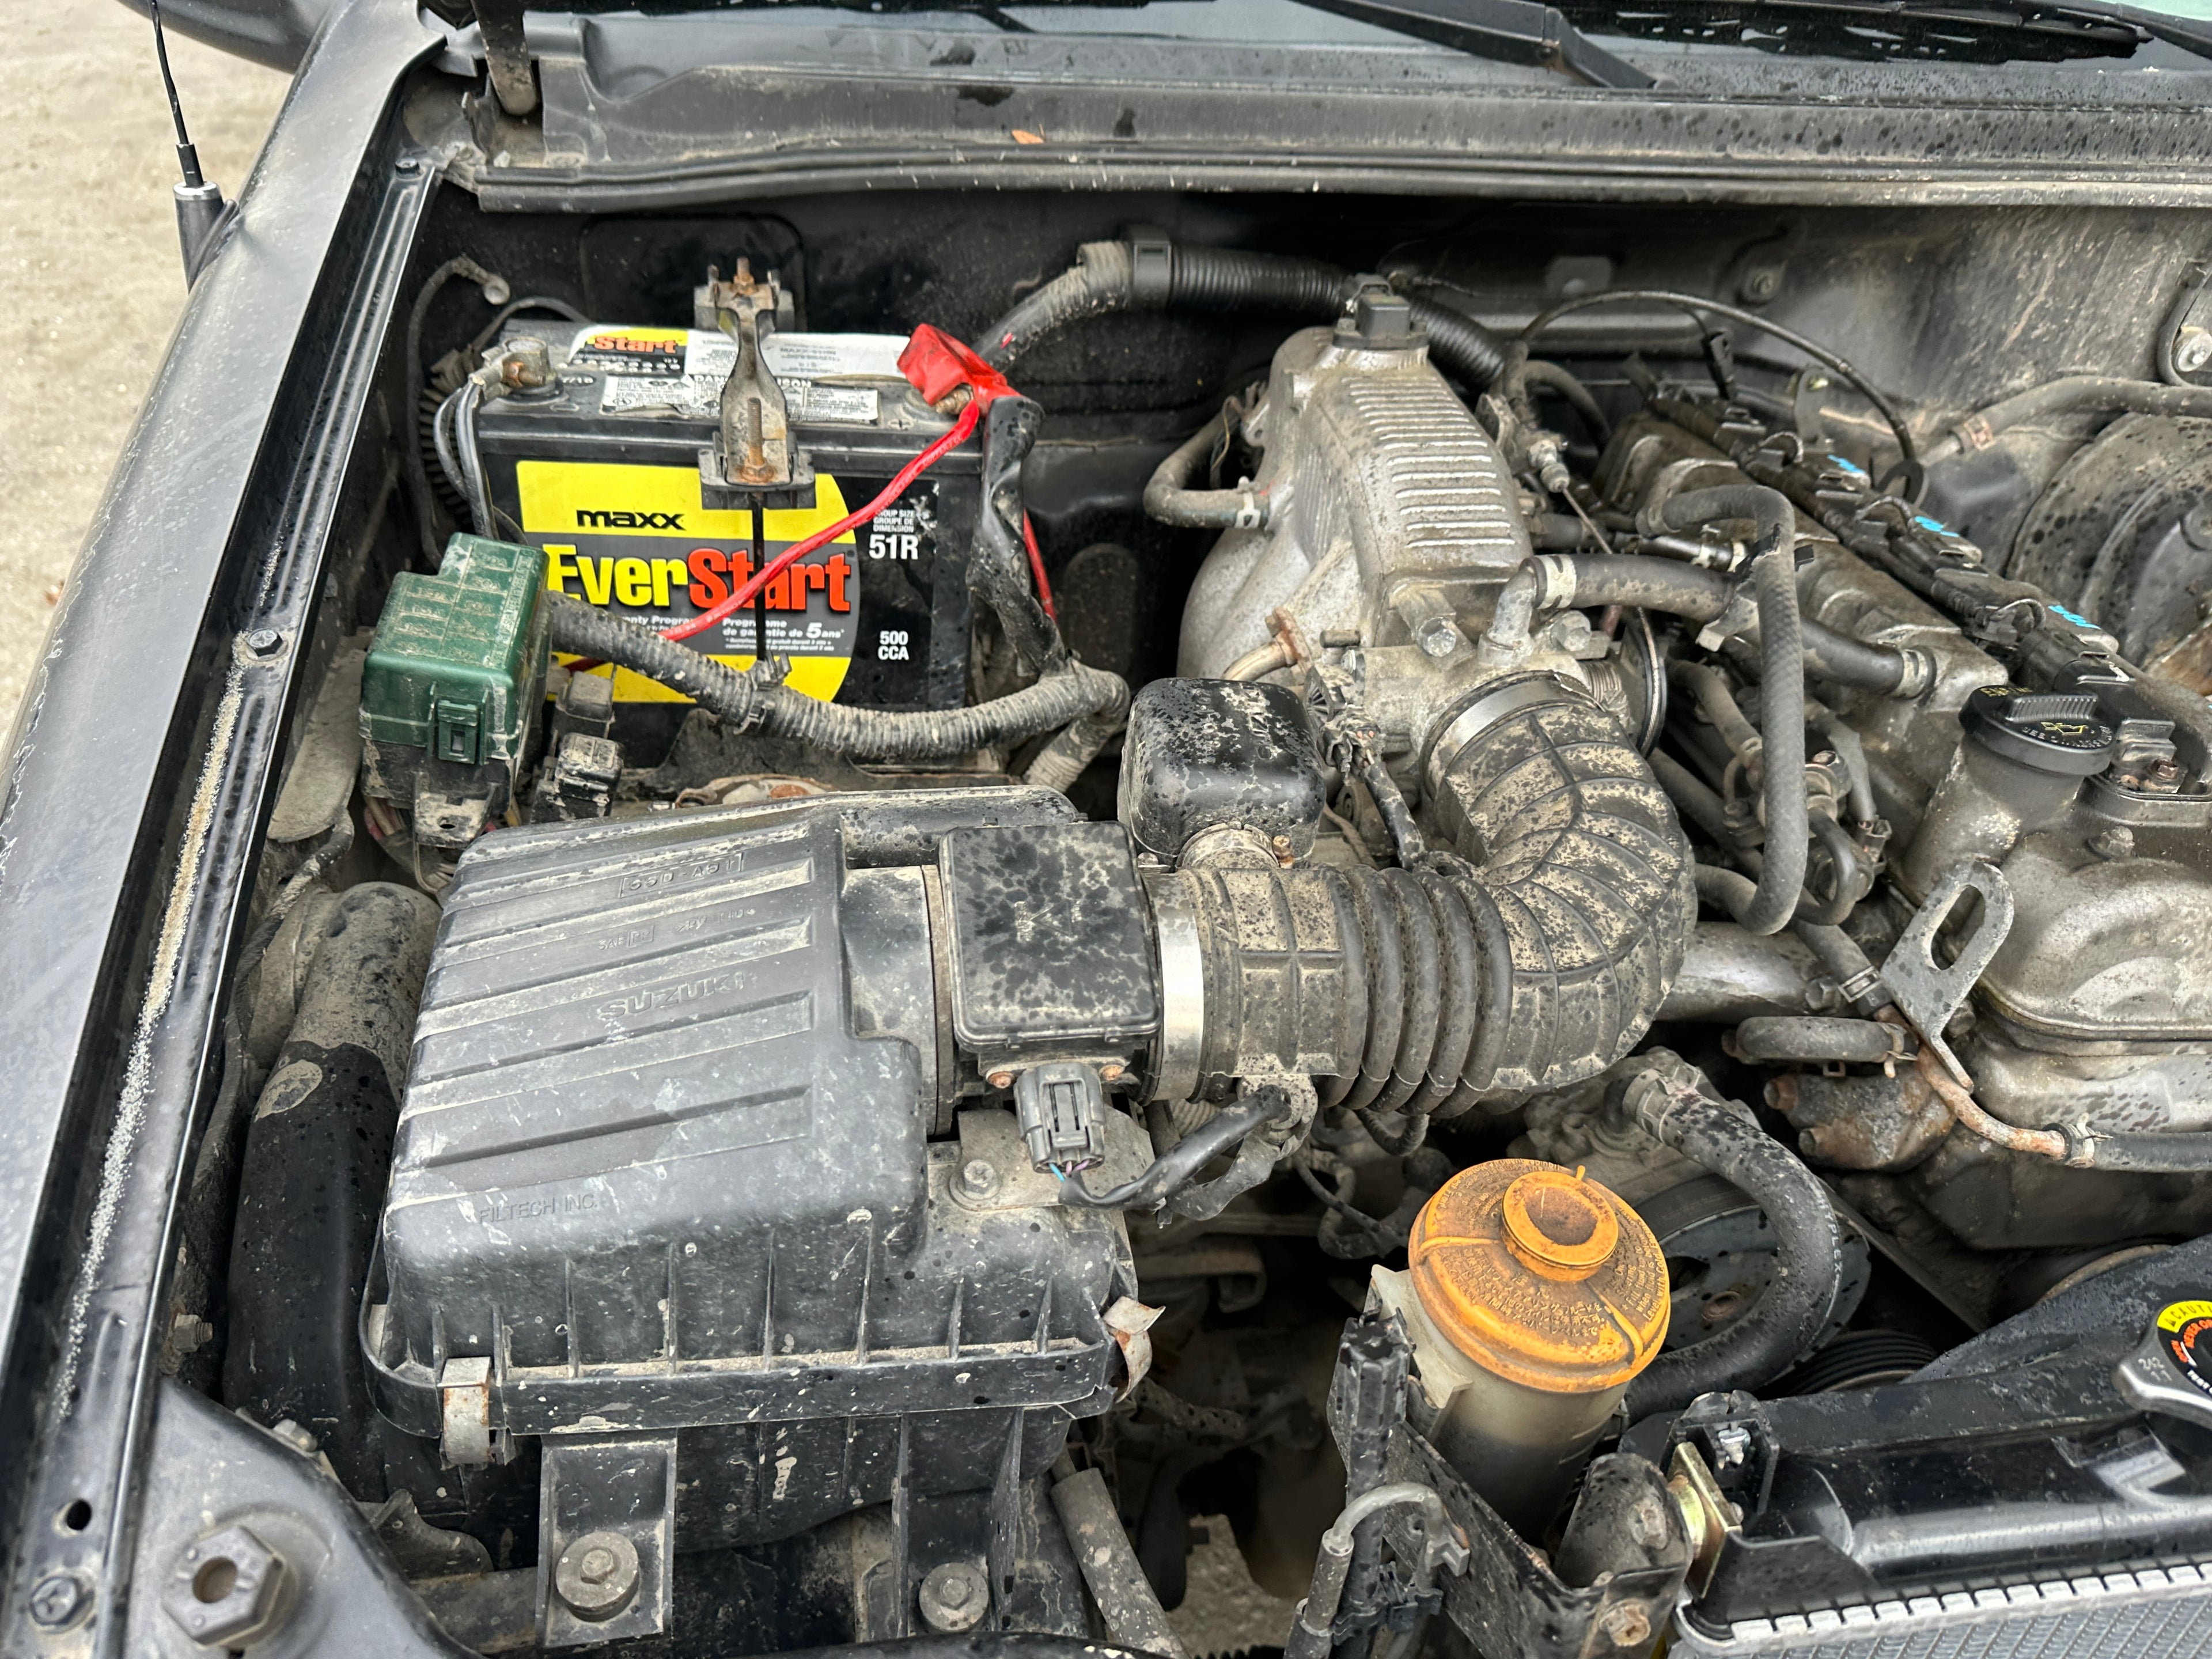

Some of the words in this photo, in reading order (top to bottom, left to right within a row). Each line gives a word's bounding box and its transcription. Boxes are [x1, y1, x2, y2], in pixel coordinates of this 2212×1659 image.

[694, 375, 728, 383] DAN
[576, 510, 686, 531] maxx
[873, 517, 903, 525] GROUPE
[904, 518, 914, 526] DE
[878, 509, 898, 518] ROUP
[899, 510, 915, 518] SIZE
[873, 524, 914, 533] DIMENSION
[869, 534, 918, 559] 51R
[543, 543, 851, 612] EverStart
[722, 618, 787, 628] Progrme
[722, 627, 737, 636] de
[740, 629, 786, 638] gantie
[789, 628, 803, 638] de
[806, 622, 823, 639] 5
[879, 630, 908, 645] 500
[877, 645, 910, 660] CCA
[597, 971, 744, 1021] SUZUKI
[479, 1197, 555, 1225] FILTECH
[565, 1192, 598, 1212] INC.
[1654, 1252, 1665, 1275] Cold
[1626, 1290, 1641, 1306] Fill
[1634, 1271, 1646, 1290] fluid
[1635, 1293, 1652, 1313] when
[1645, 1271, 1656, 1291] fluid
[1656, 1277, 1666, 1298] with
